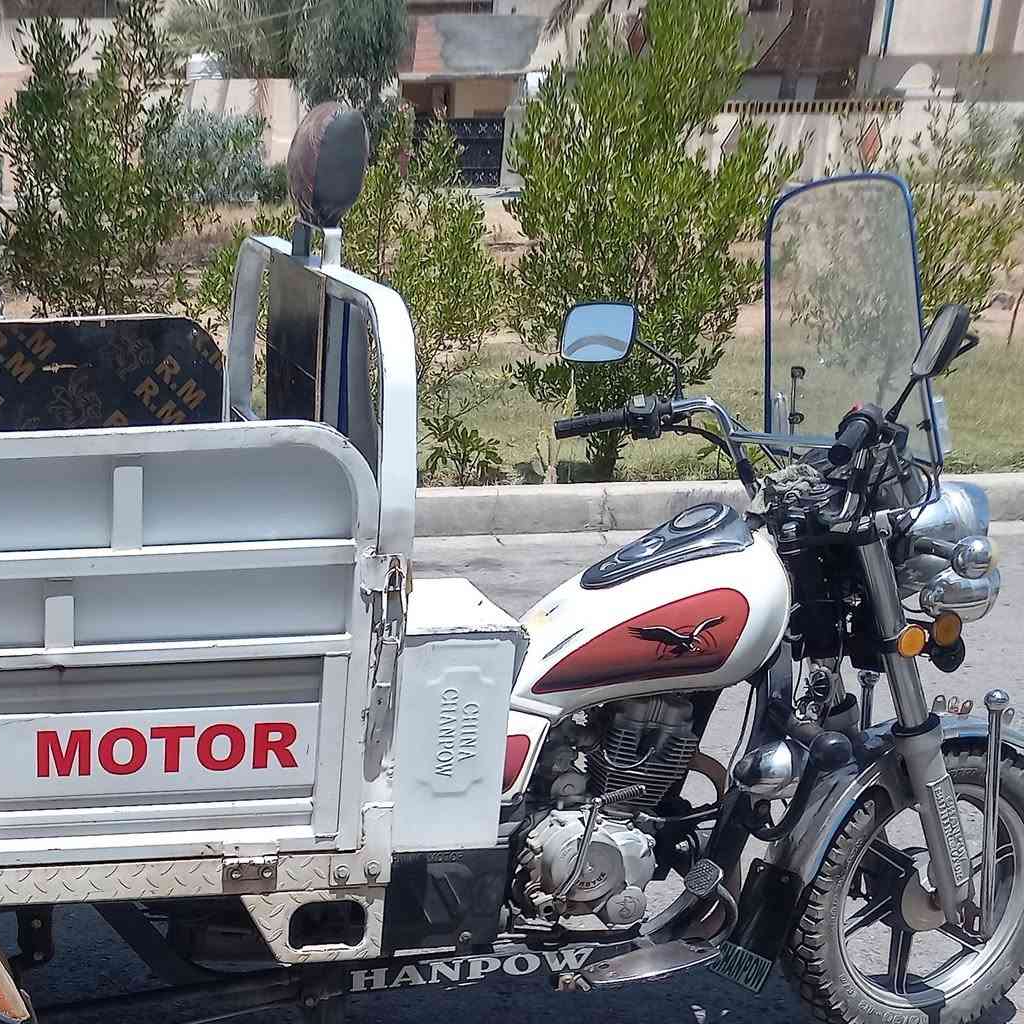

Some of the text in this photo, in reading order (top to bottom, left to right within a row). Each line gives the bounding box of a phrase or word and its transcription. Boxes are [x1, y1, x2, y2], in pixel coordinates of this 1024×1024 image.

[36, 722, 299, 778] MOTOR
[433, 688, 460, 778] CHANPOW
[458, 702, 481, 762] CHINA
